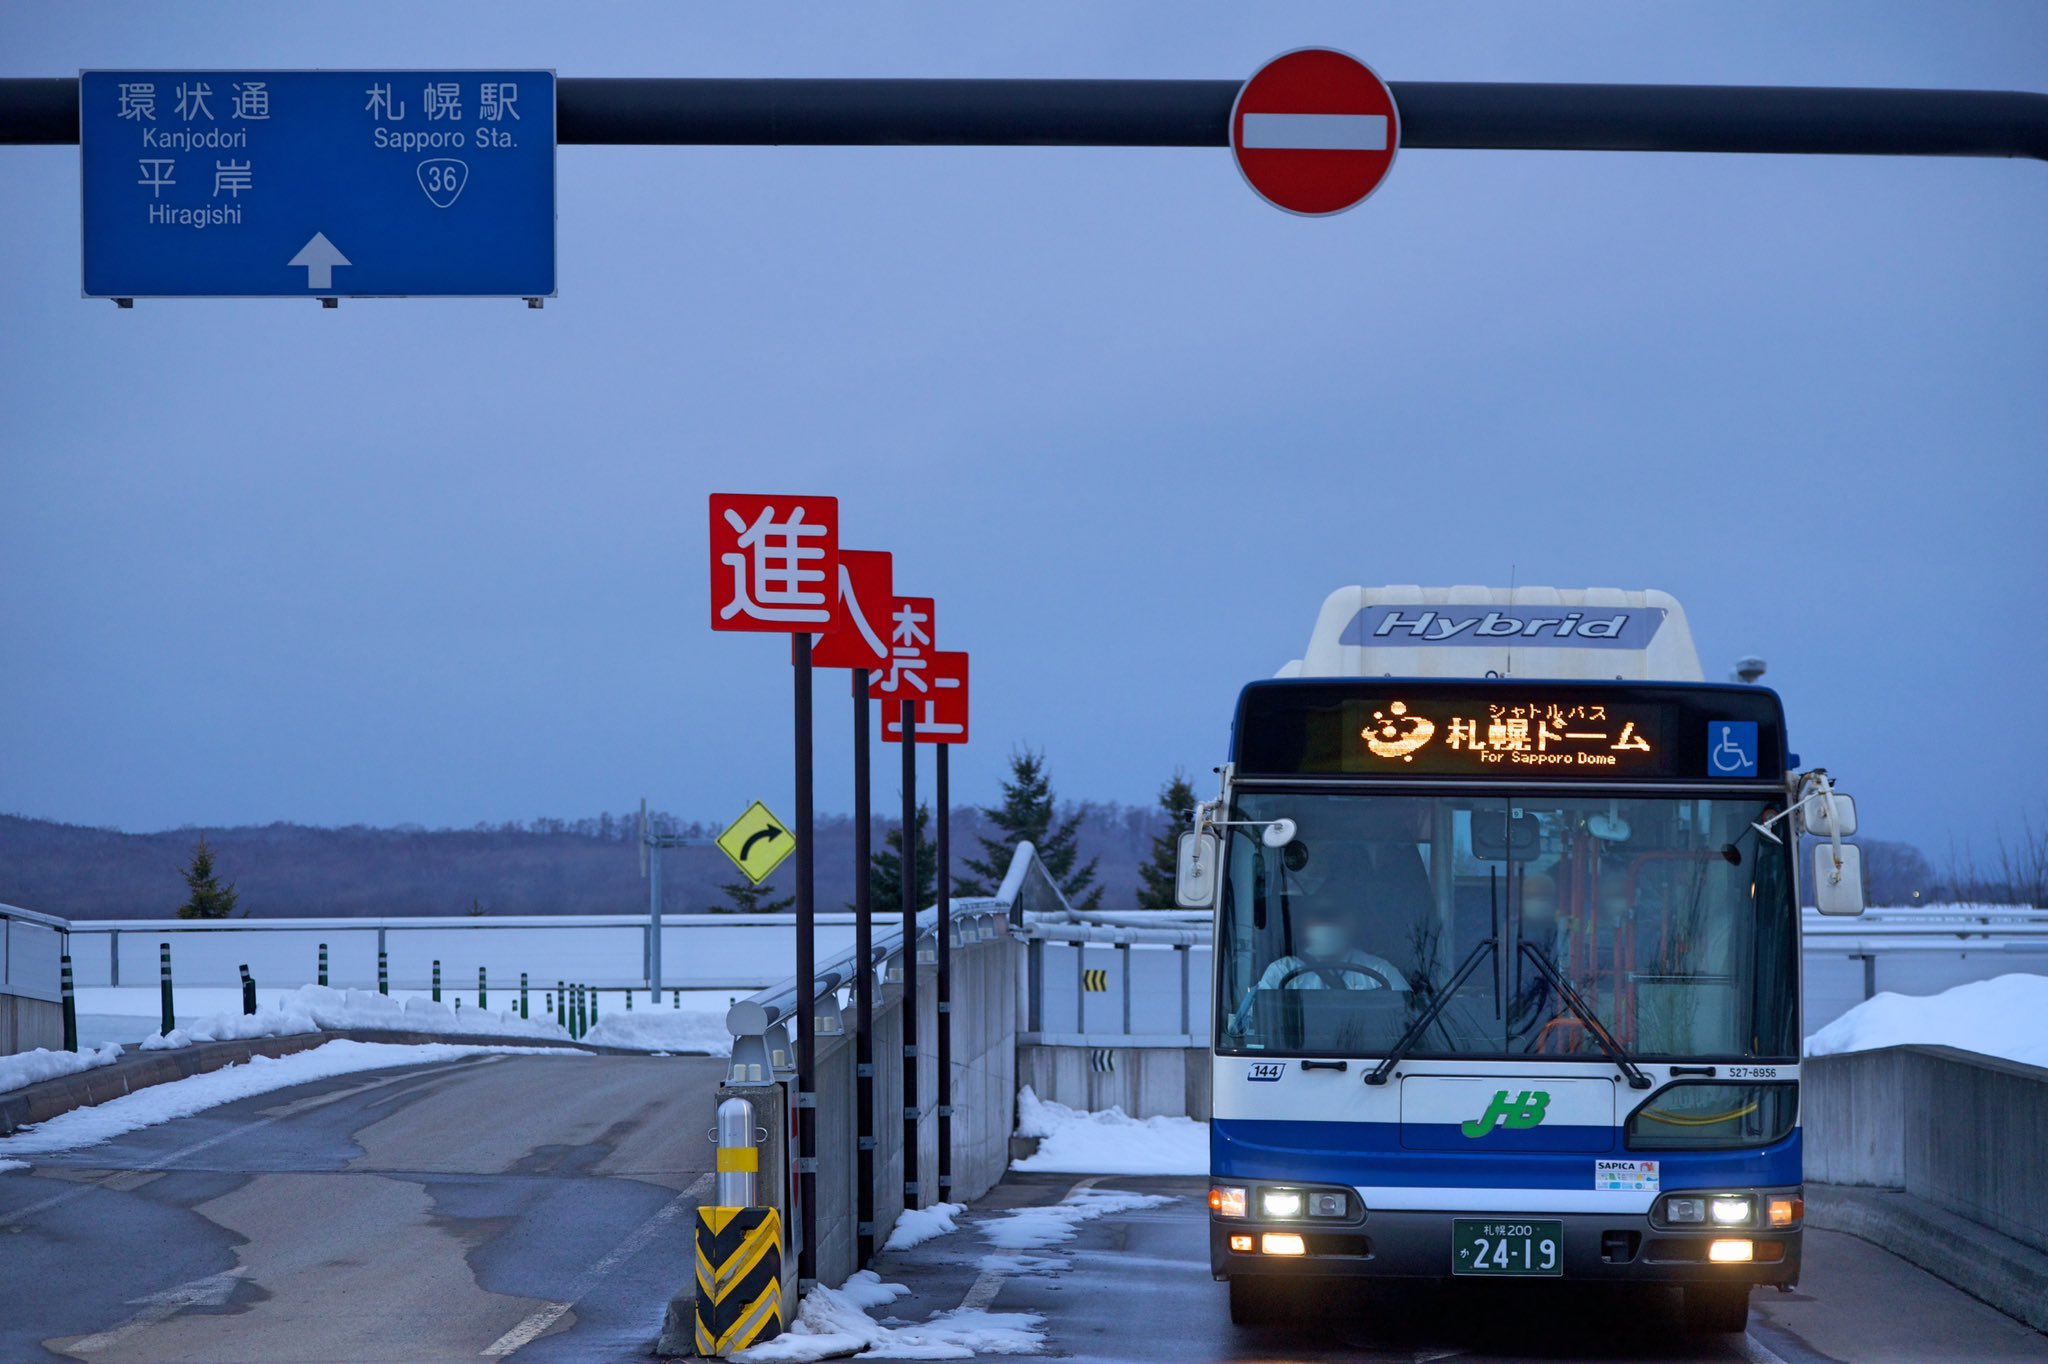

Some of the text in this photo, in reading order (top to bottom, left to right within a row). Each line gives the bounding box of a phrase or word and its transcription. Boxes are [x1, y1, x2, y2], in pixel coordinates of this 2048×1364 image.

[117, 81, 271, 122] 環状通
[365, 82, 520, 122] 札幌駅
[143, 128, 247, 152] Kanjodori
[374, 127, 518, 153] Sapporo Sta.
[137, 158, 253, 198] 平岸
[428, 166, 456, 192] 36
[149, 204, 241, 229] Hiragishi
[720, 505, 830, 622] 進
[1373, 611, 1629, 640] Hybrid
[1488, 704, 1606, 720] シャトルバス
[1446, 717, 1650, 751] 札幌ドーム
[1481, 751, 1616, 765] For Sapporo Dome
[1254, 1065, 1278, 1077] 144
[1729, 1068, 1776, 1078] 527-8956
[1598, 1162, 1635, 1170] SAPICA
[1473, 1238, 1556, 1269] 24-19
